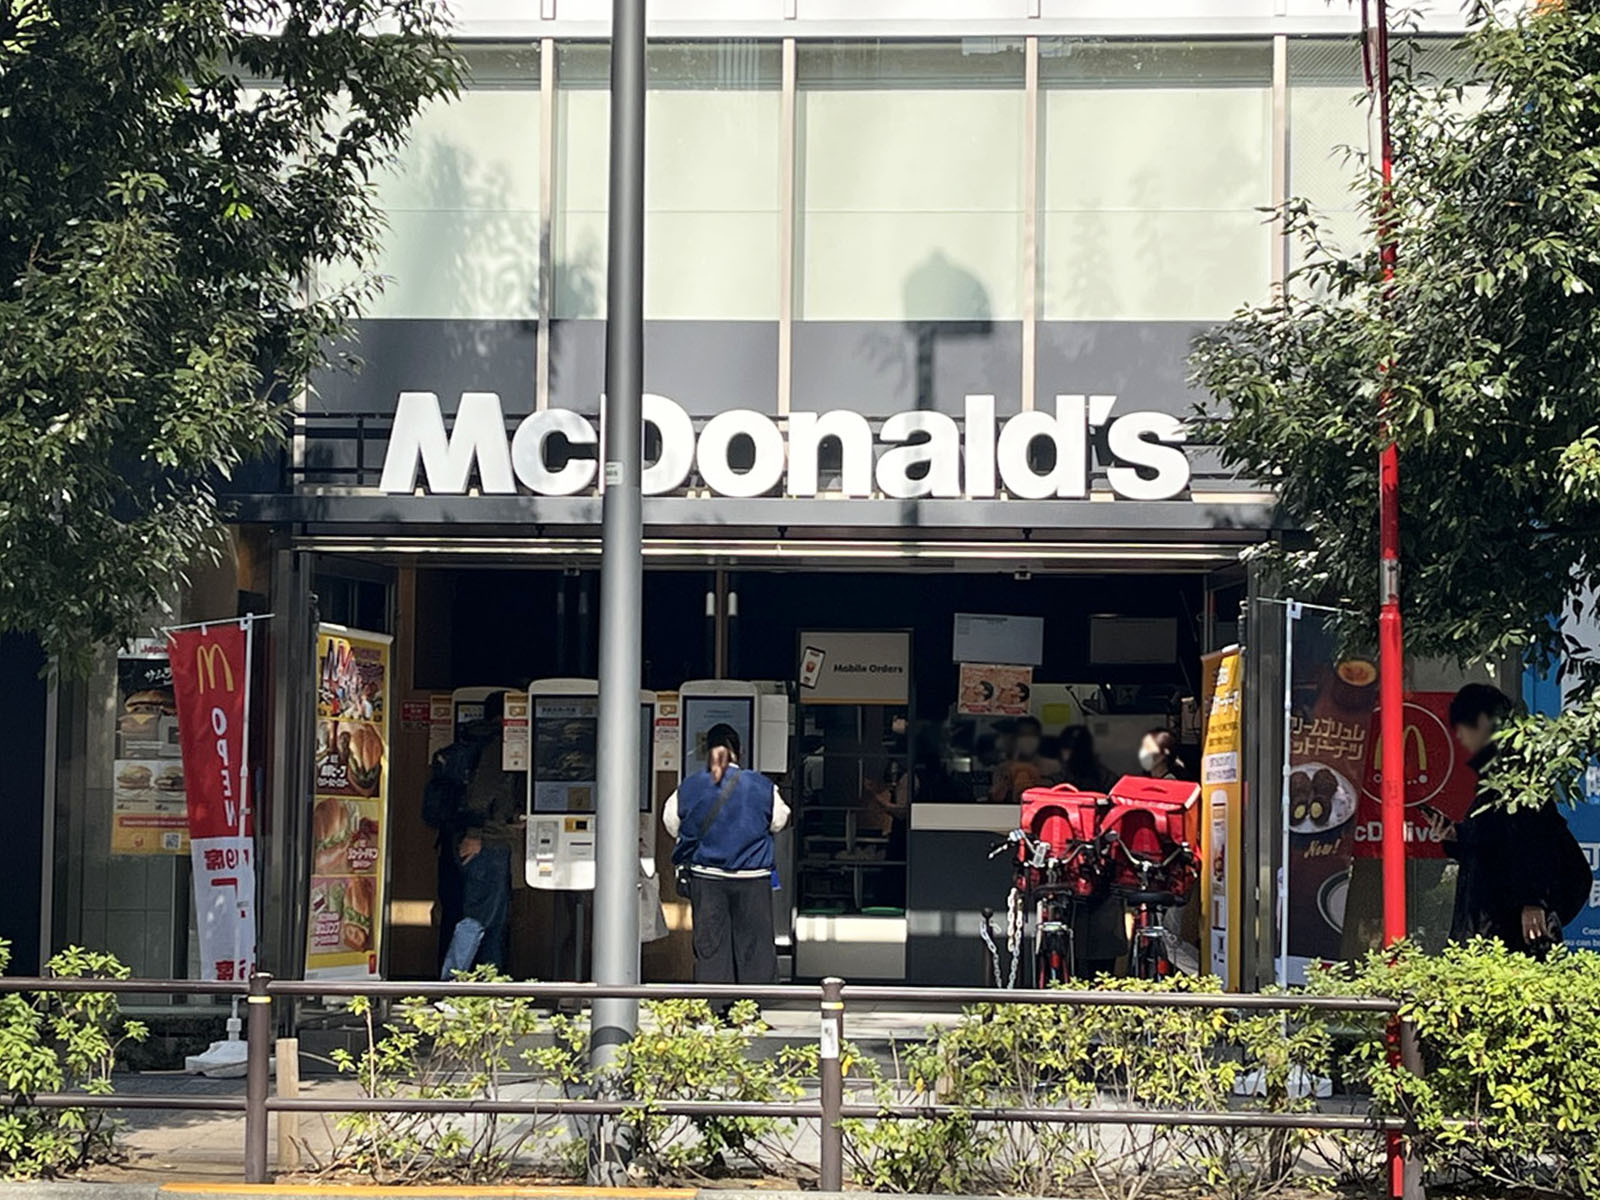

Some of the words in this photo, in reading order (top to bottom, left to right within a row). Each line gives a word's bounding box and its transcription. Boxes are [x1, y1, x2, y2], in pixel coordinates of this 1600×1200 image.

[379, 391, 1191, 499] McDonald's
[144, 667, 173, 682] サムラ
[833, 663, 867, 673] Mobile
[868, 663, 904, 673] Orders
[1292, 737, 1364, 760] ットドーナツ
